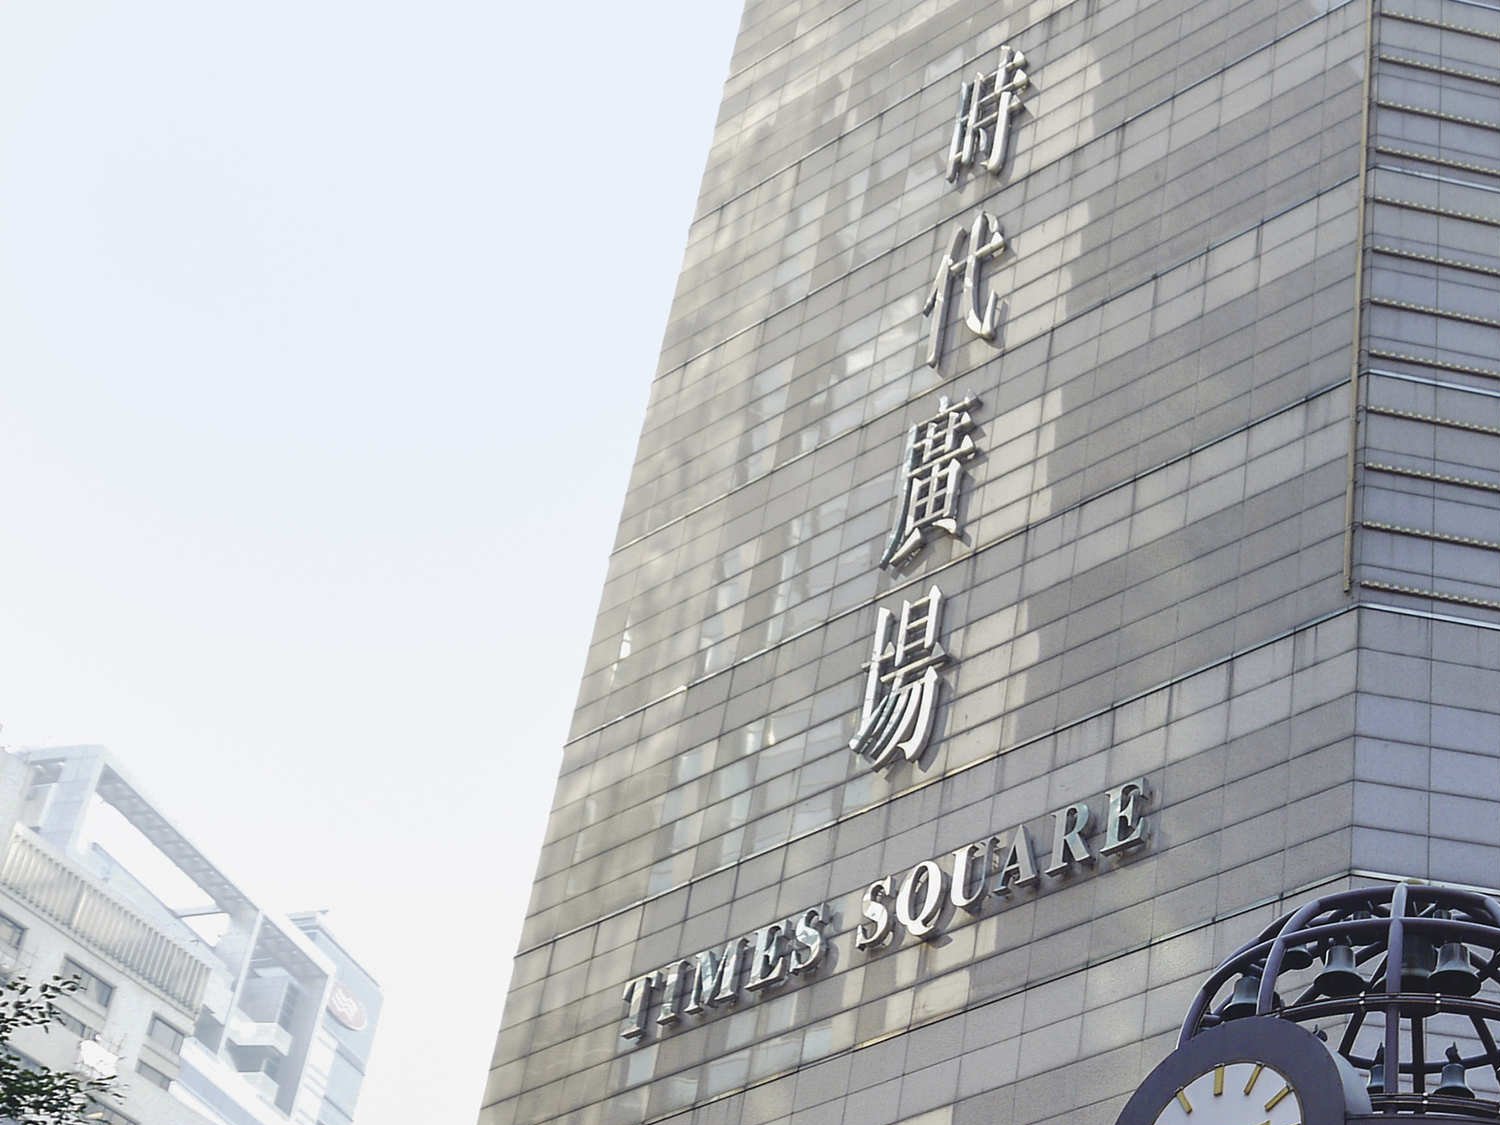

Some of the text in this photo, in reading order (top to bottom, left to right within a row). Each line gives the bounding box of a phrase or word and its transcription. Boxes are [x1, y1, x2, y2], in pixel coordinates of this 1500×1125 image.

[848, 44, 1031, 773] 時代廣場
[620, 777, 1149, 1040] TIMES SQUARE
